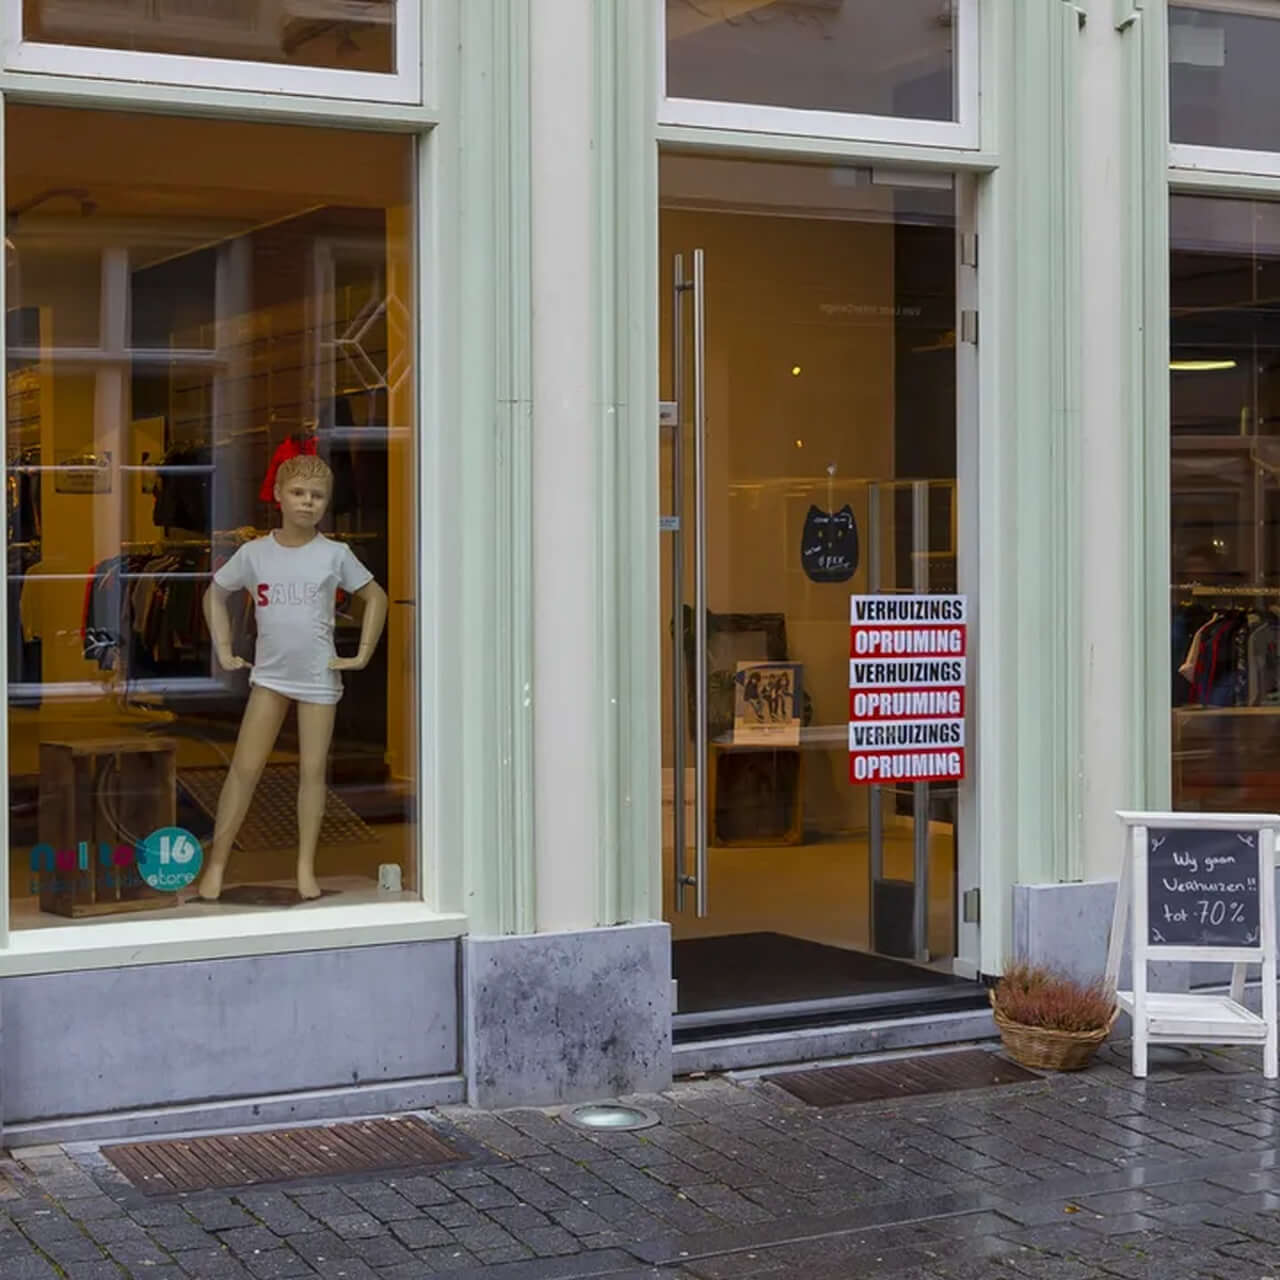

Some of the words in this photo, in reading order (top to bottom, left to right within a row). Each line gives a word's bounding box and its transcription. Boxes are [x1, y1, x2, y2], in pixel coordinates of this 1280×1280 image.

[256, 583, 320, 607] SALE
[856, 599, 963, 621] VERHUIZINGS
[855, 629, 962, 654] OPRUIMING
[854, 662, 961, 683] VERHUIZINGS
[853, 691, 961, 717] OPRUIMING
[853, 723, 961, 746] VERHUIZINGS
[853, 752, 961, 780] OPRUIMING
[159, 835, 196, 865] 16
[1204, 856, 1236, 872] gaan
[147, 868, 195, 887] store
[1164, 903, 1188, 922] tot
